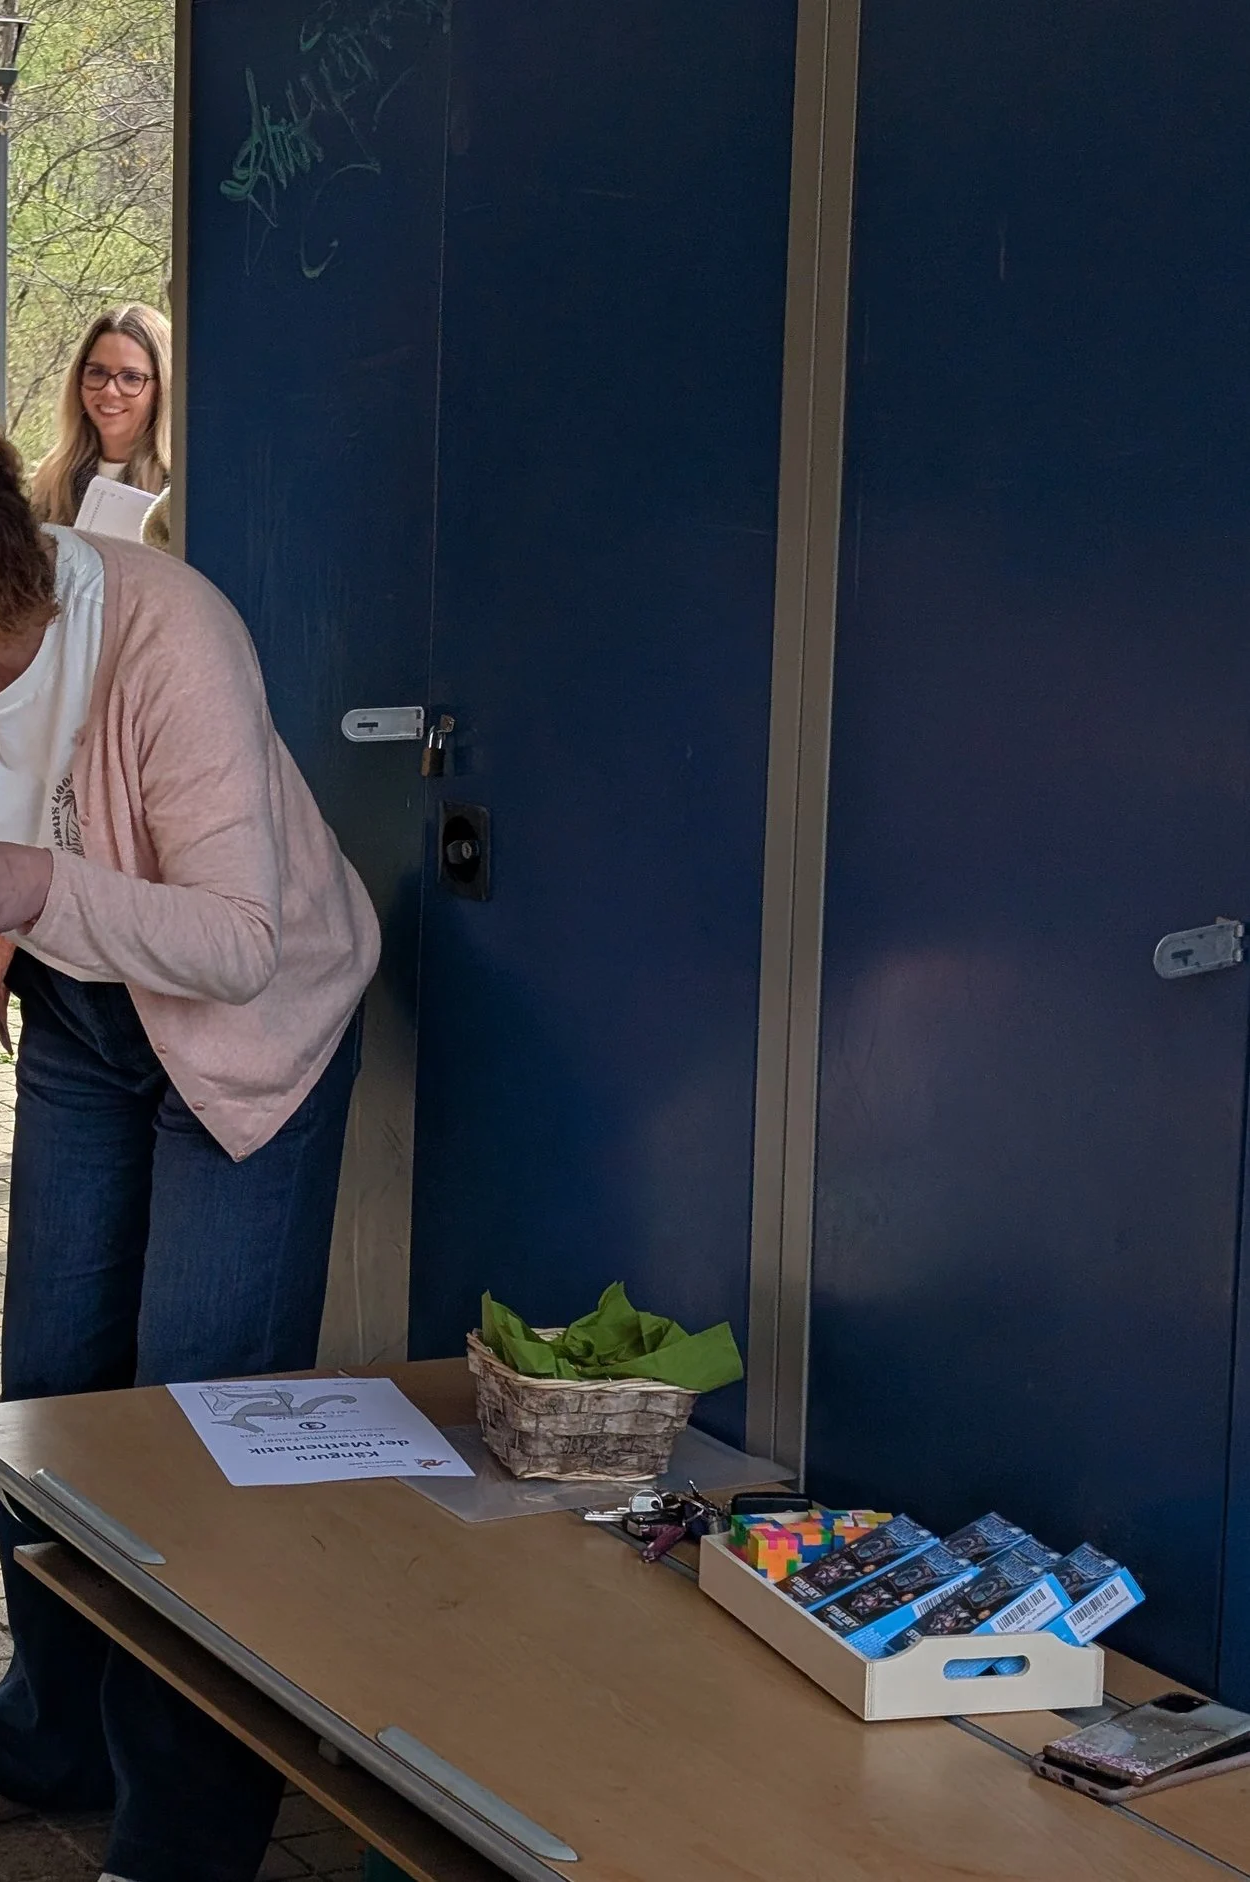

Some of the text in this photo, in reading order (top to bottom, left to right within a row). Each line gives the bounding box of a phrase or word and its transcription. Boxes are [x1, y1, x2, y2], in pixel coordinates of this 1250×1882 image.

[51, 806, 64, 851] LWAYS
[248, 1439, 410, 1455] der Mathematik
[295, 1450, 379, 1462] Känguru
[791, 1576, 823, 1599] STAR SKY
[826, 1605, 860, 1628] STAR SKY
